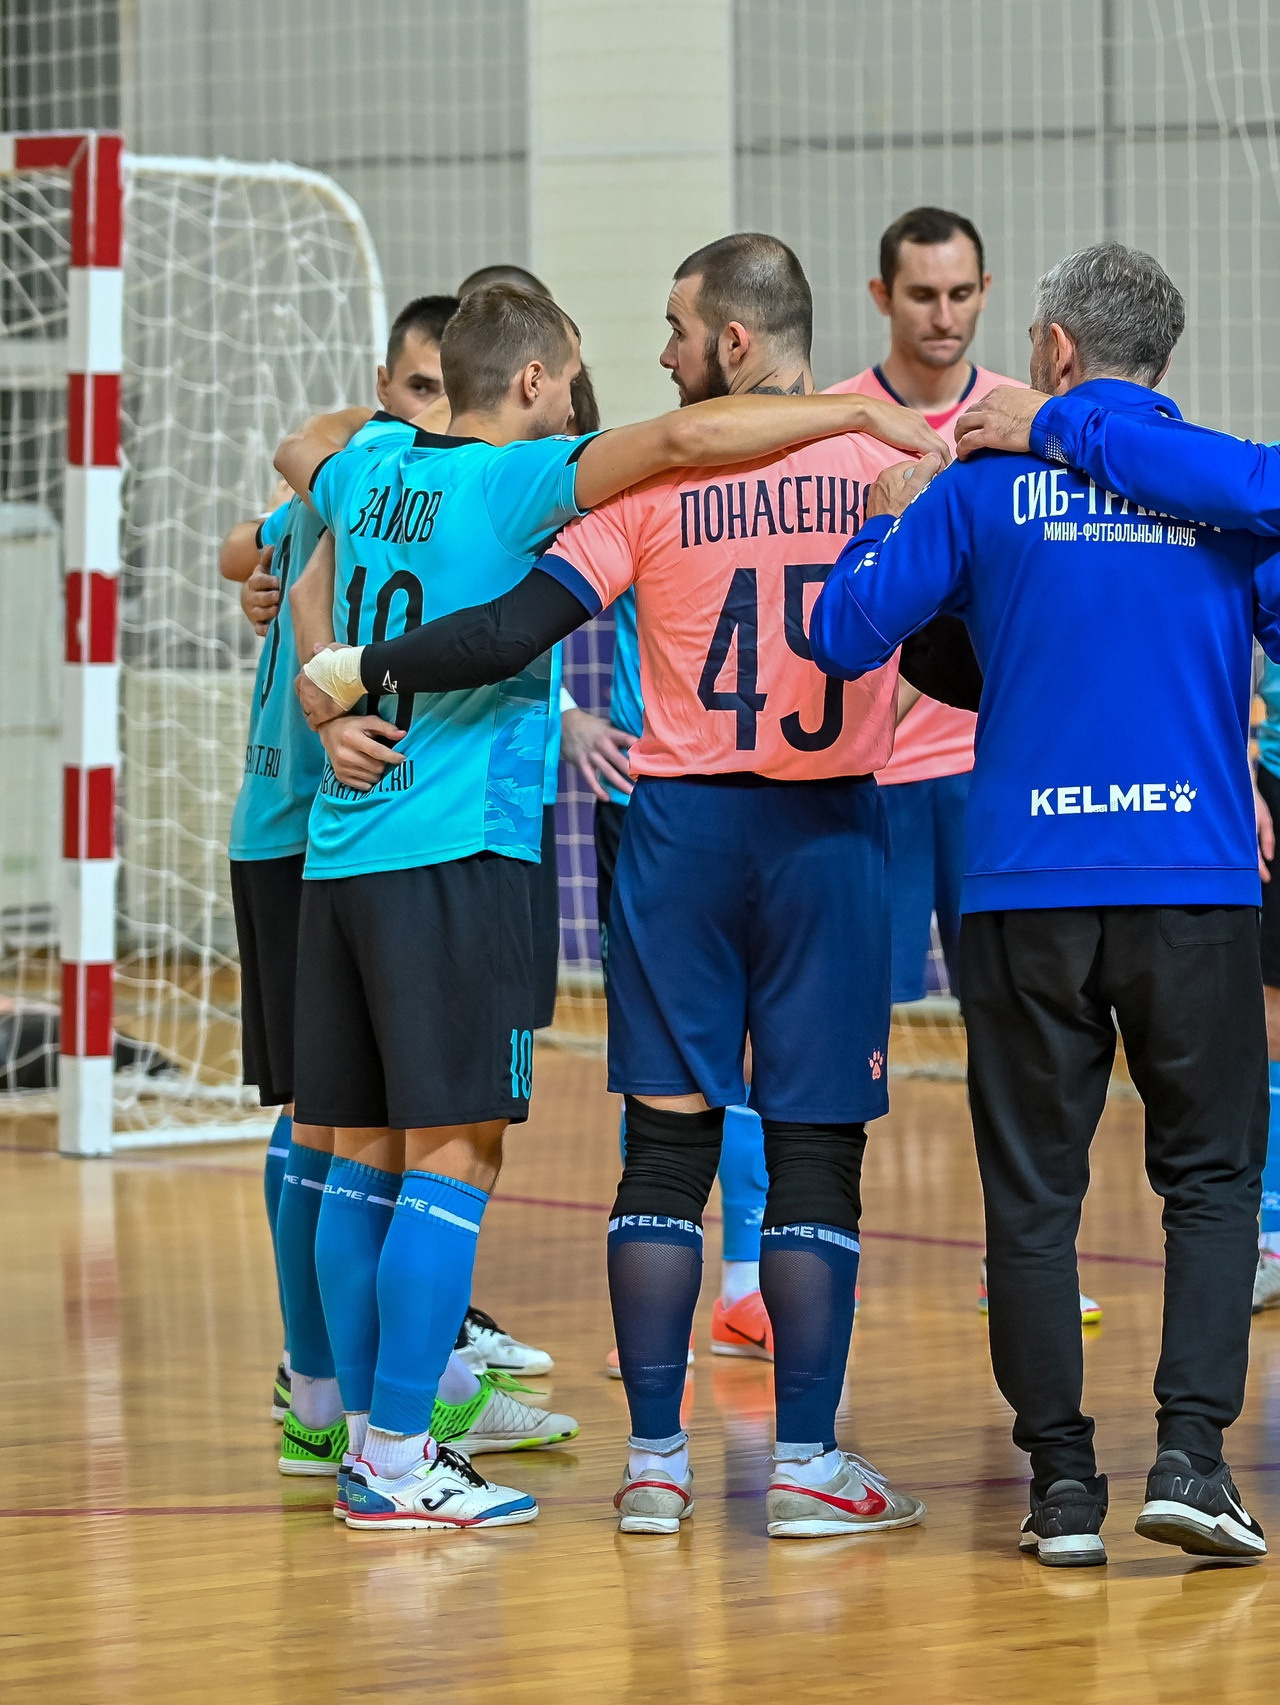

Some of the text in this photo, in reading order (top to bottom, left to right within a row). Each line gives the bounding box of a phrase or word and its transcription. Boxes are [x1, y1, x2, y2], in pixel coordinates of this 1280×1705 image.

[1043, 521, 1196, 547] МИНИ-ФУТБОЛЬНЫЙ КЛУБ
[697, 563, 844, 752] 45
[1030, 783, 1167, 817] KELME
[509, 1028, 532, 1100] 10
[621, 1215, 695, 1233] KELME
